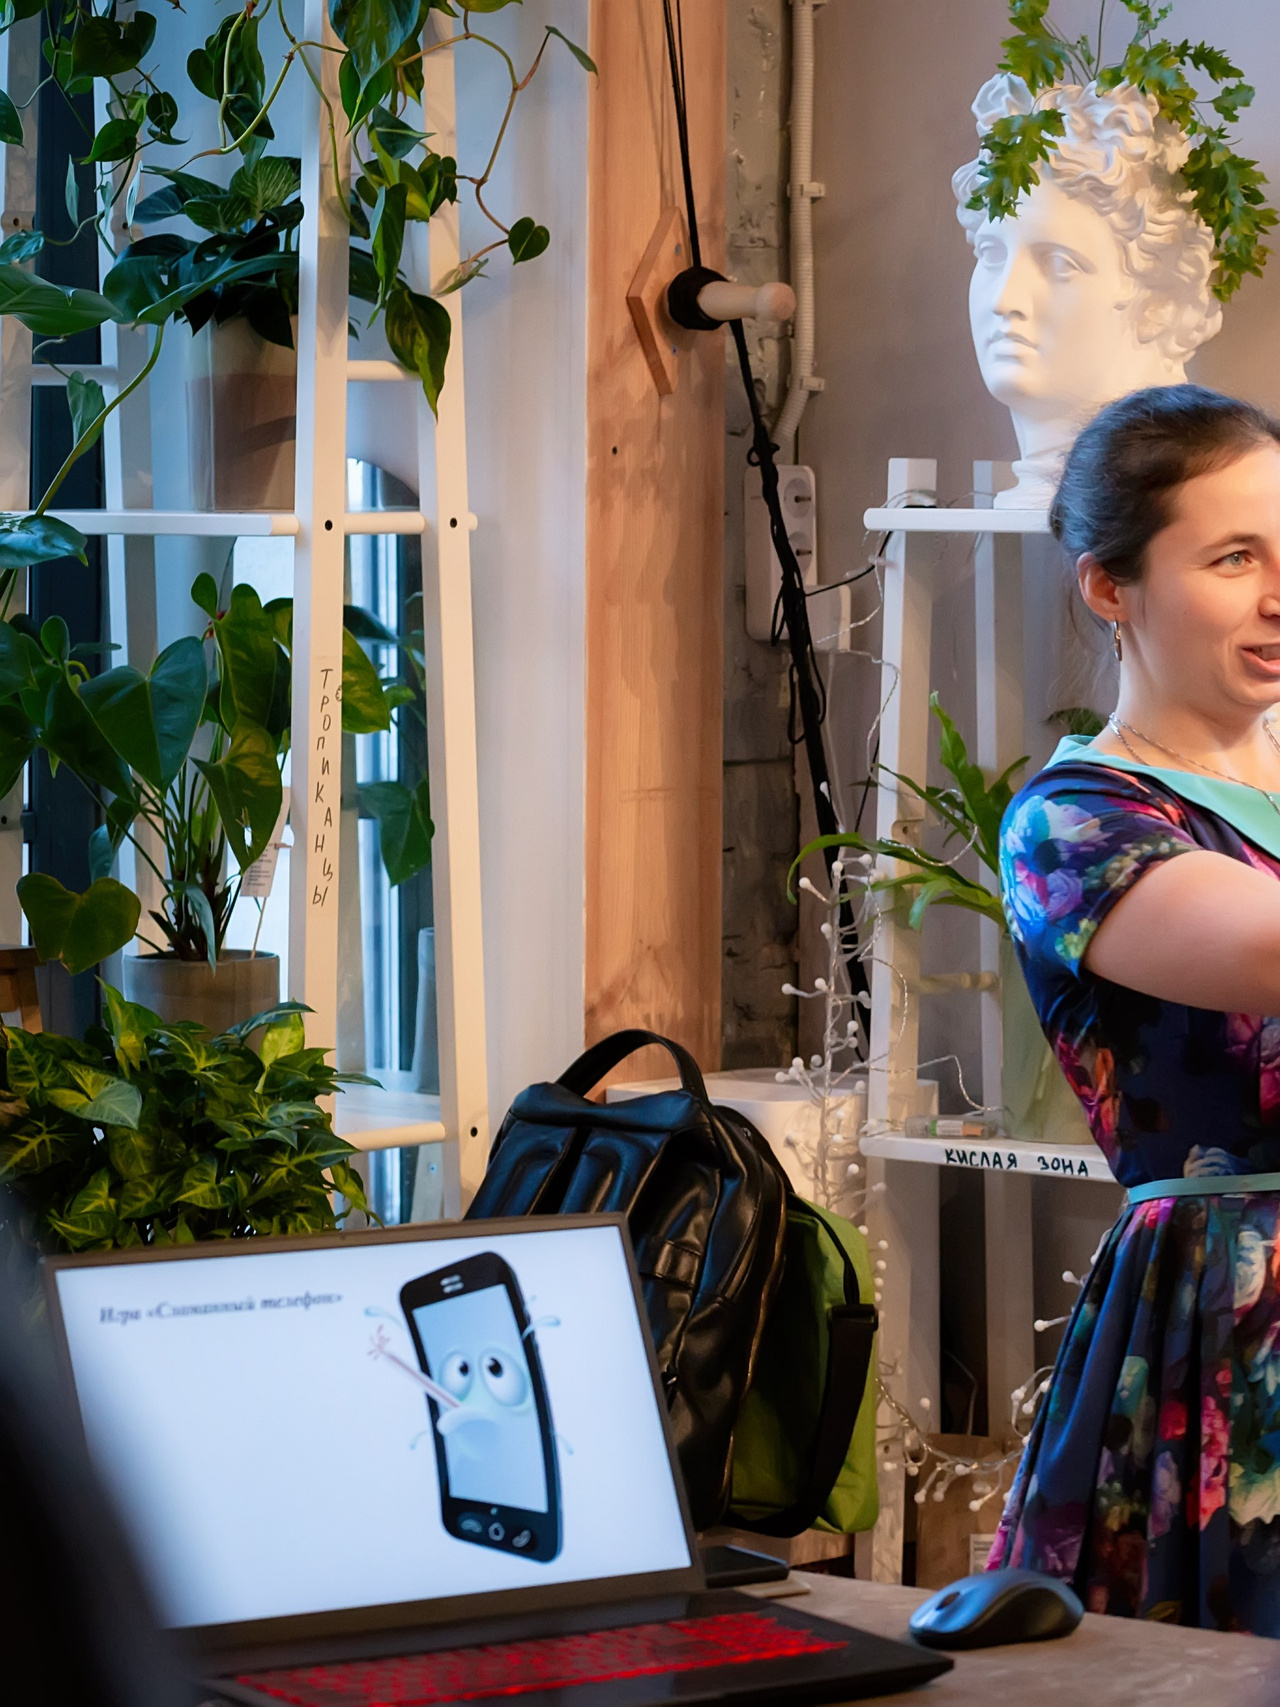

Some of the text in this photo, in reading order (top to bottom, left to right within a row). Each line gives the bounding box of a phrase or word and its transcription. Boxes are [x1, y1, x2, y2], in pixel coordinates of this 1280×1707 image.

[312, 668, 334, 907] ТРОПИКАНЦЫ
[944, 1148, 1089, 1177] КИСЛАЯ ЗОНА
[99, 1306, 142, 1327] Игра
